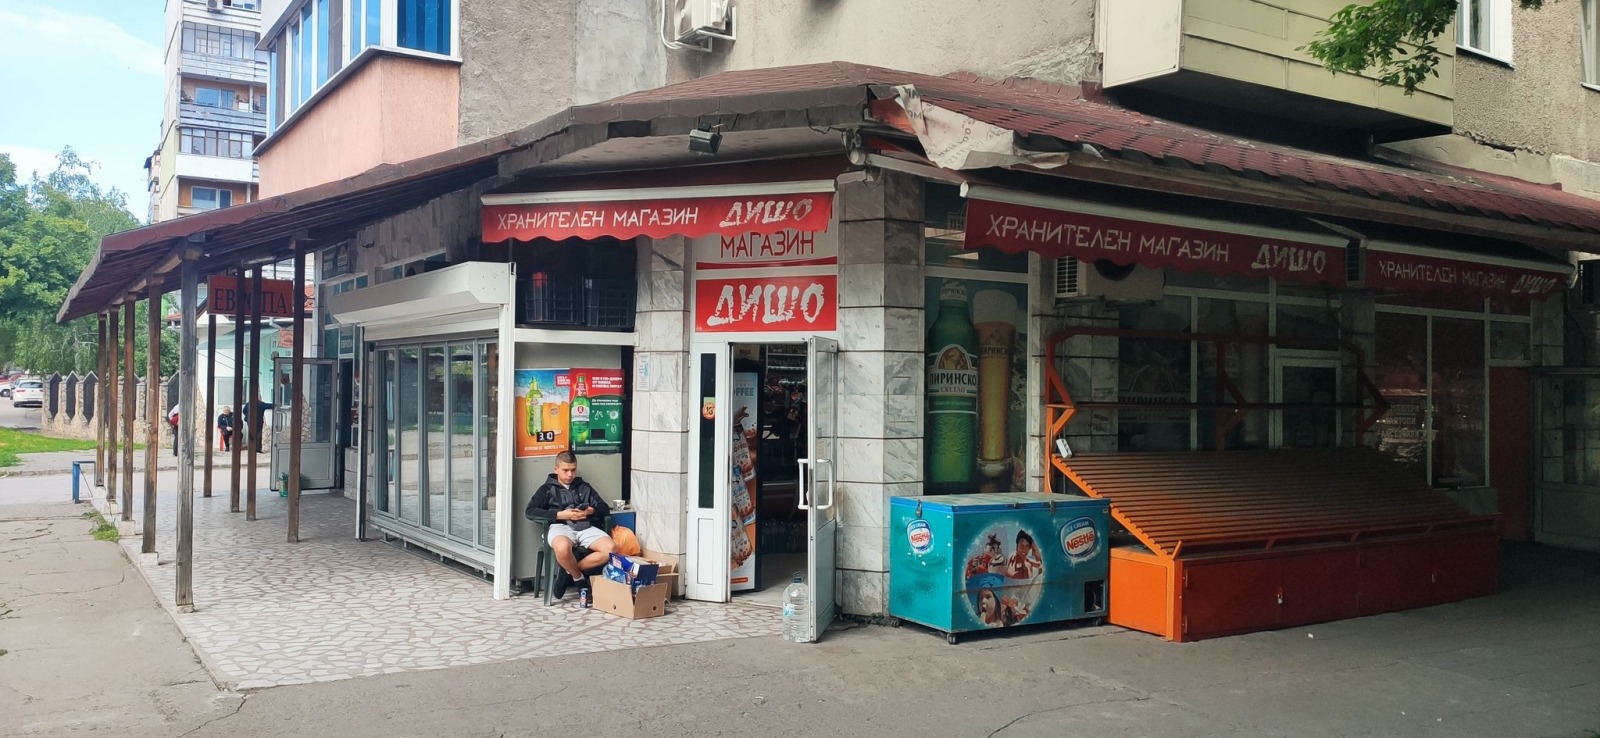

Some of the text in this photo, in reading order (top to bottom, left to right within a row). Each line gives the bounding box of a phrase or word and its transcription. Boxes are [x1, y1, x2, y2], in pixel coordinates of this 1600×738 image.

[498, 198, 812, 230] ХРАНИТЕЛЕН МАГАЗИН ДИШО
[720, 230, 814, 258] МАГАЗИН
[986, 214, 1326, 274] ХРАНИТЕЛЕН МАГАЗИН ДИШО
[1378, 260, 1456, 284] ХРАНИТЕЛЕН
[1462, 271, 1507, 288] МАГАЗИН
[214, 288, 288, 314] ЕВПА
[706, 283, 824, 326] ДИШО
[734, 388, 754, 397] FFEE
[930, 372, 977, 386] ПИРИНСКО
